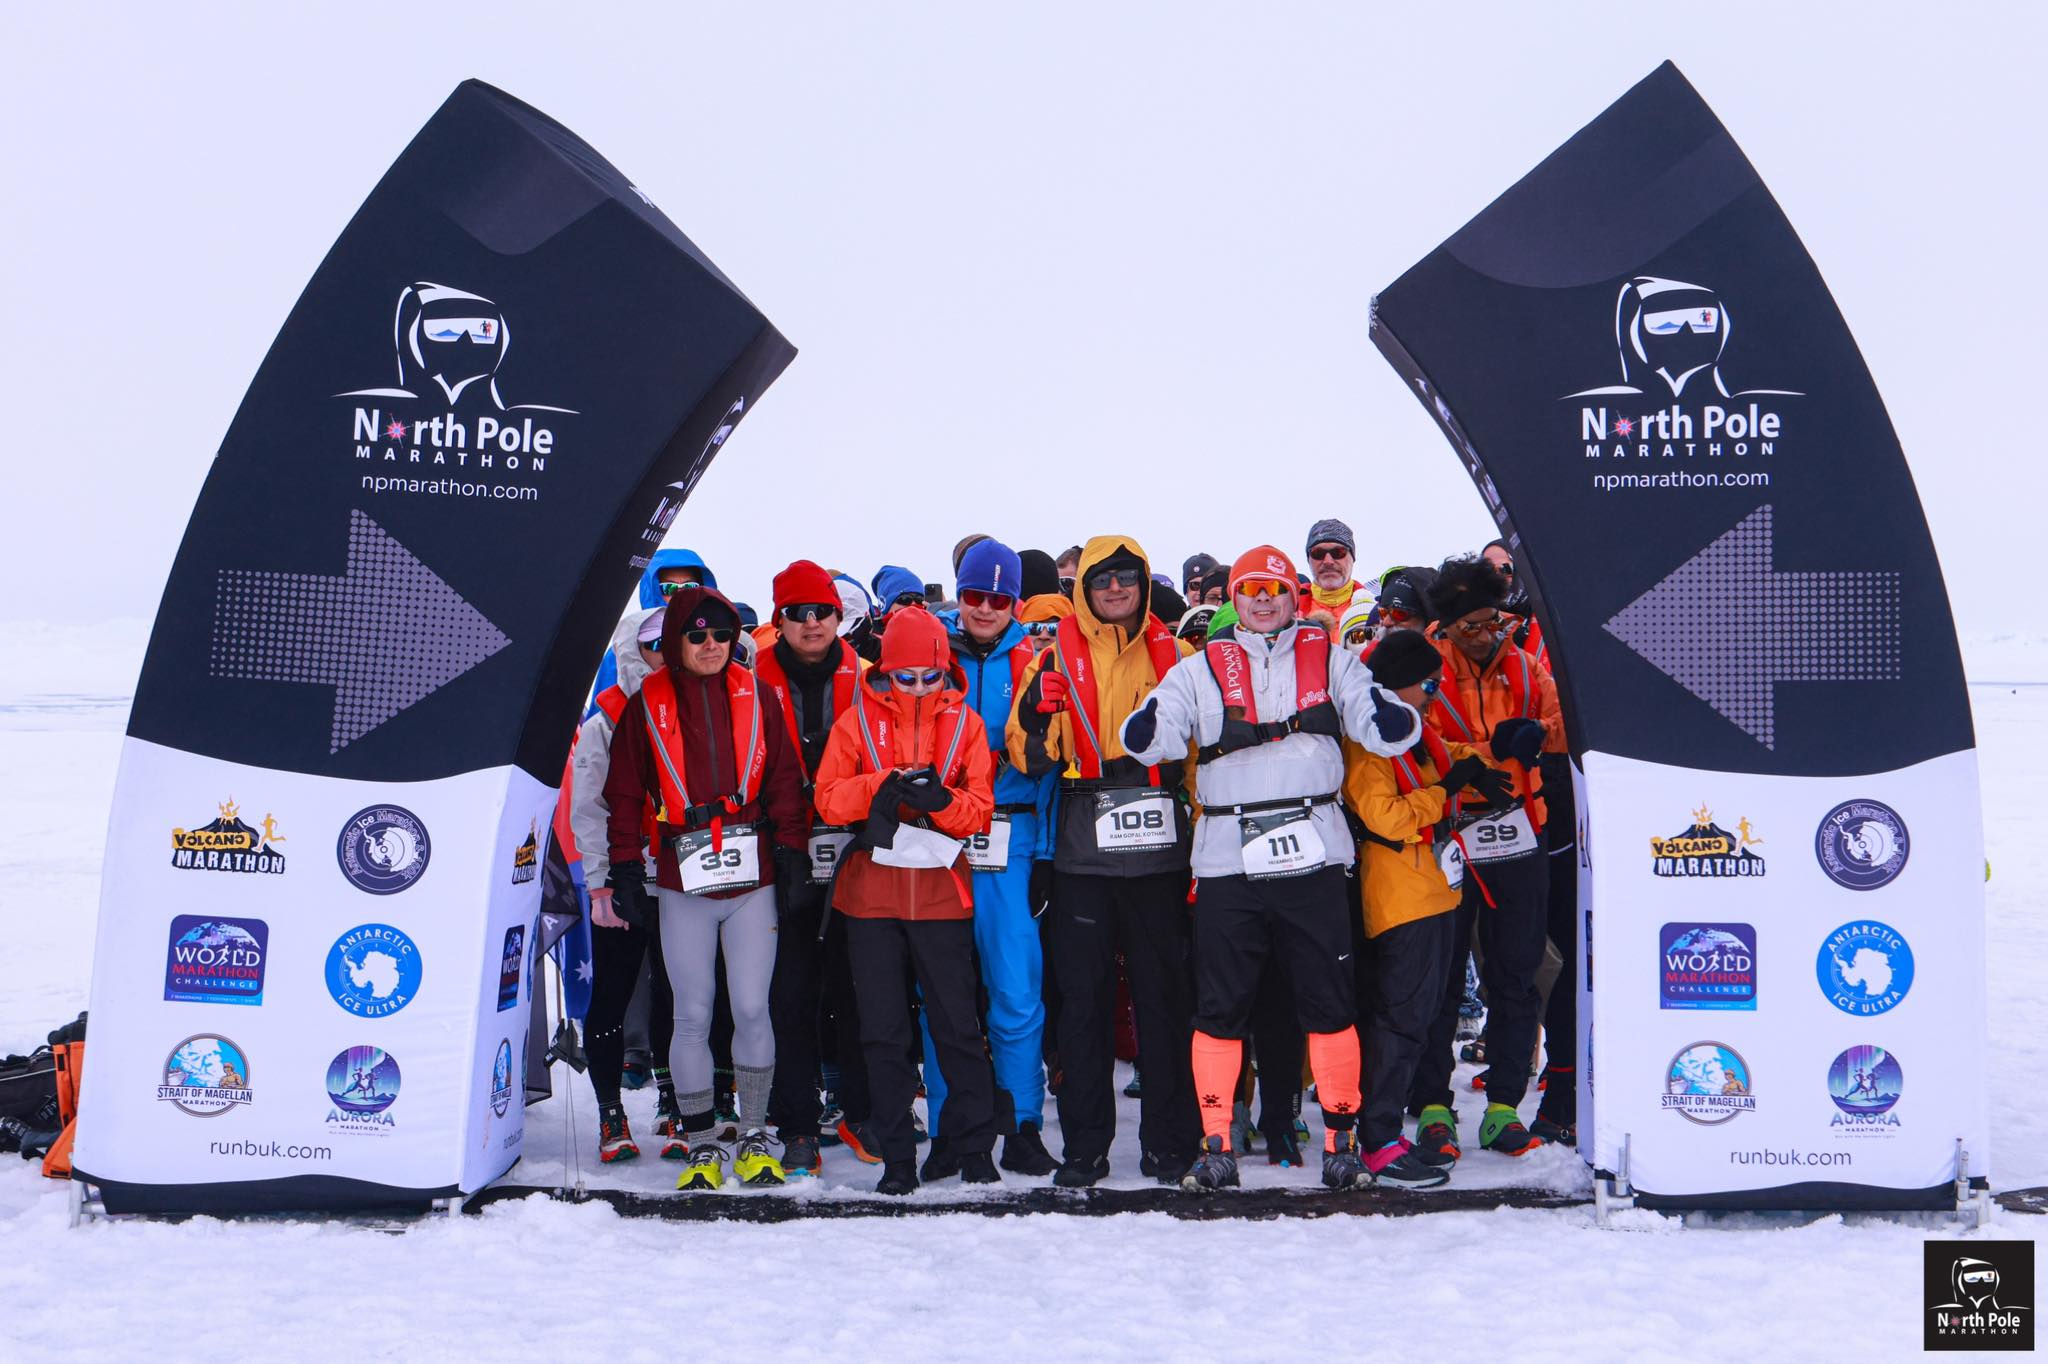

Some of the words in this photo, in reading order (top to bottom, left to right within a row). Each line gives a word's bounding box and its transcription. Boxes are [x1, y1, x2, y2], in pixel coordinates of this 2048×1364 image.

[1703, 403, 1781, 439] Pole
[476, 416, 554, 454] Pole
[356, 445, 545, 471] MARATHON
[1585, 442, 1774, 457] MARATHON
[361, 475, 539, 500] npmarathon.com
[1594, 470, 1770, 491] npmarathon.com
[1221, 643, 1240, 688] PONANT
[357, 815, 375, 828] Ice
[1111, 810, 1163, 830] 108
[1832, 811, 1850, 825] Ice
[173, 832, 245, 848] VOLCANO
[1477, 824, 1518, 843] 39
[1268, 834, 1300, 857] 111
[1652, 840, 1722, 855] VOLCANO
[176, 850, 284, 874] MARATHON
[700, 848, 742, 871] 33
[1657, 857, 1765, 875] MARATHON
[339, 927, 412, 955] ANTARCTIC
[1828, 924, 1901, 953] ANTARCTIC
[172, 964, 259, 979] MARATHON
[1665, 972, 1751, 983] MARATHON
[175, 977, 254, 988] CHALLENGE
[1670, 985, 1747, 993] CHALLENGE
[338, 993, 361, 1012] ICE
[367, 994, 407, 1015] ULTRA
[1833, 992, 1856, 1011] ICE
[1862, 991, 1902, 1013] ULTRA
[157, 1086, 190, 1098] STRAIT
[191, 1088, 202, 1098] OF
[204, 1089, 253, 1102] MAGELLAN
[182, 1099, 227, 1107] MARATHON
[1661, 1094, 1693, 1107] STRAIT
[1695, 1096, 1706, 1106] OF
[1708, 1096, 1756, 1109] MAGELLAN
[325, 1108, 396, 1127] AURORA
[1830, 1111, 1902, 1127] AURORA
[210, 1139, 332, 1161] runbuk.com
[1730, 1149, 1851, 1166] runbuk.com
